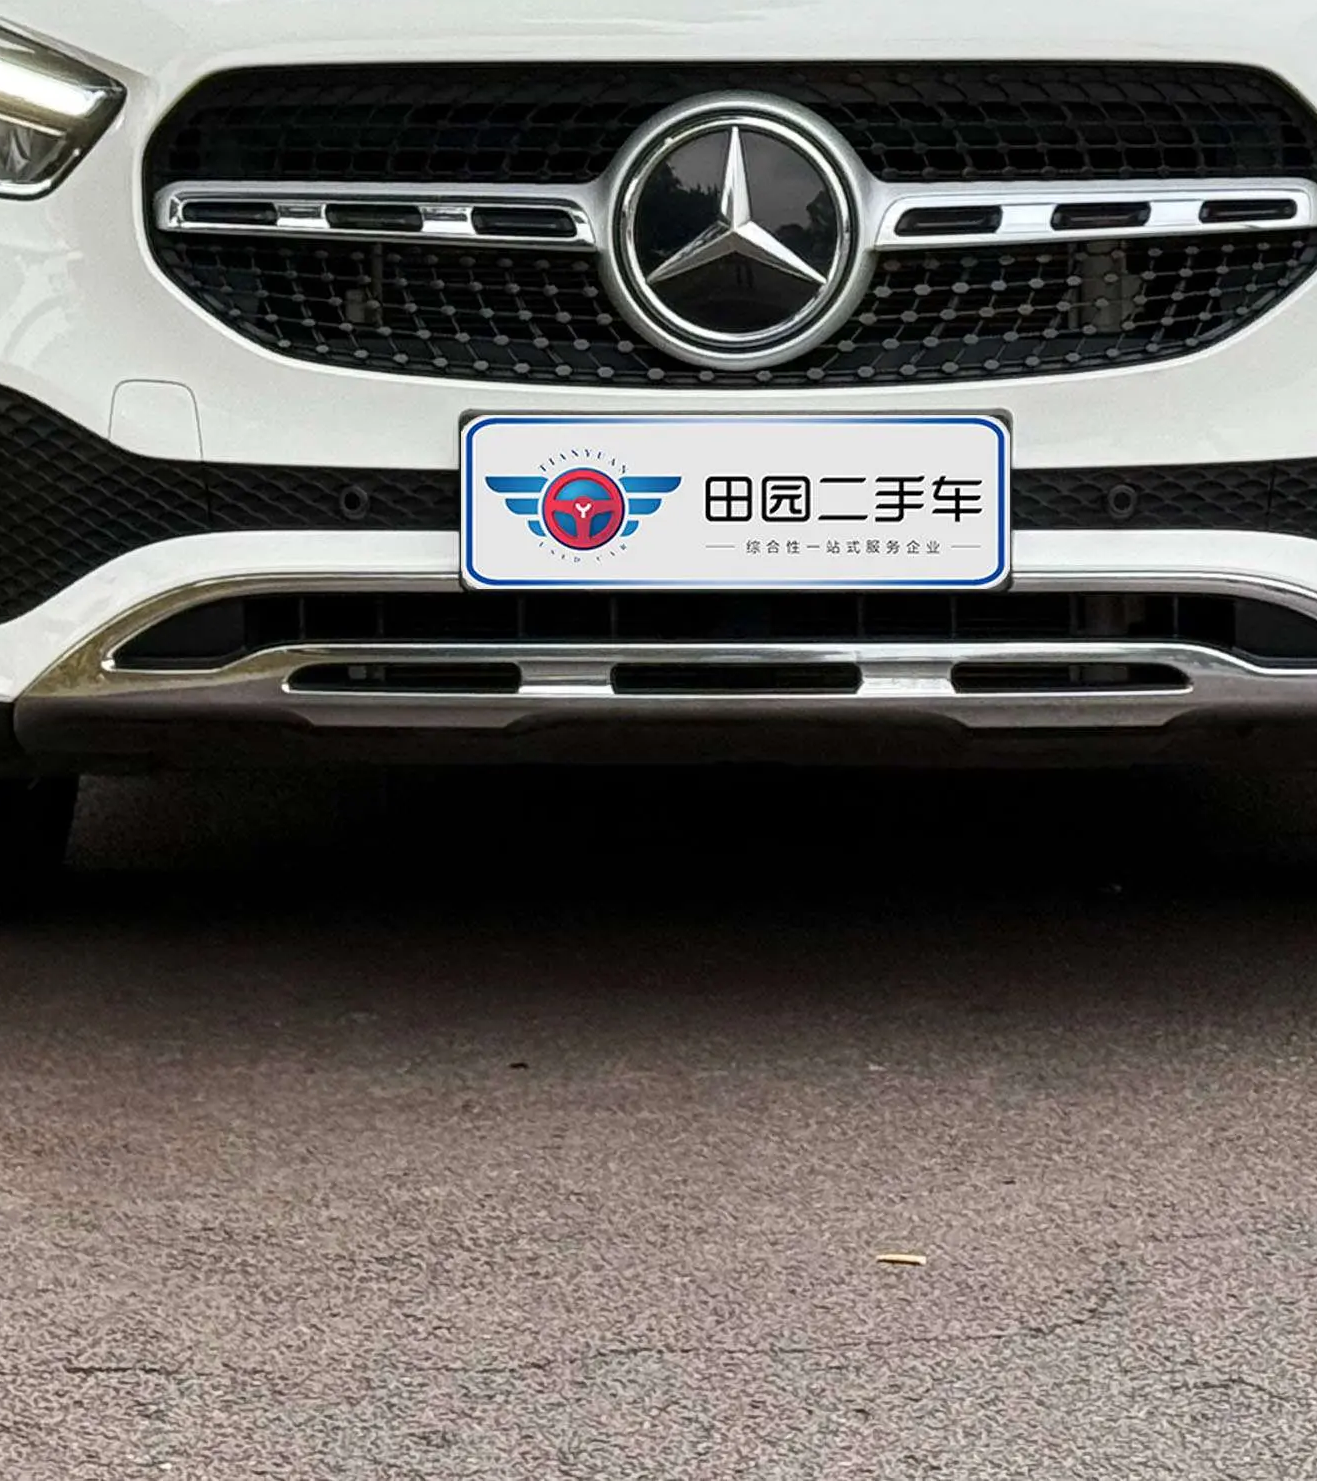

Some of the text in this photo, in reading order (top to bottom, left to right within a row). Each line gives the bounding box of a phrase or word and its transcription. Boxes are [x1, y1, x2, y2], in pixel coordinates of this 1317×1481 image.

[705, 475, 983, 522] 田园二手车
[746, 540, 941, 555] 综合性一站式服务企业
